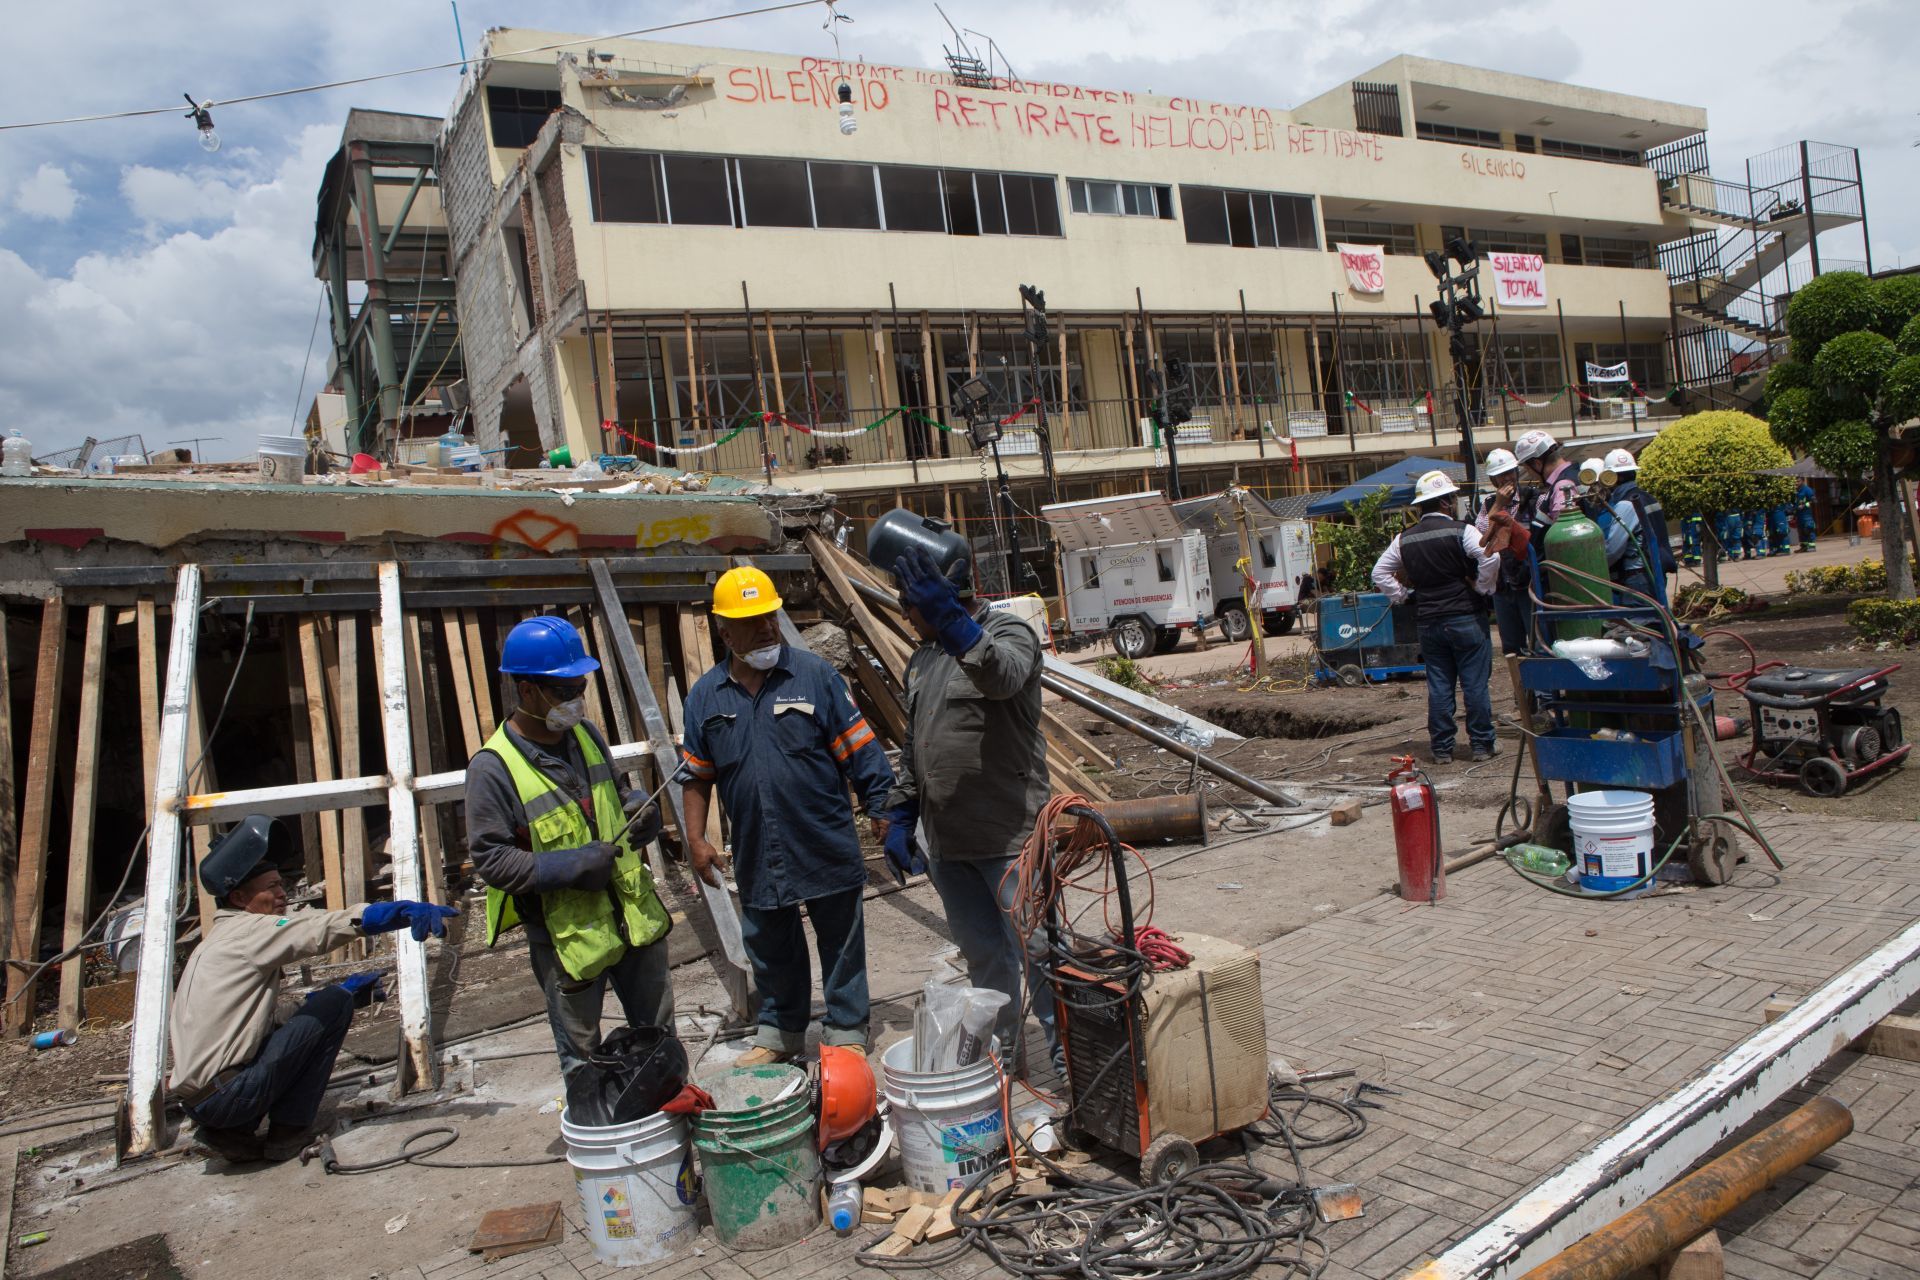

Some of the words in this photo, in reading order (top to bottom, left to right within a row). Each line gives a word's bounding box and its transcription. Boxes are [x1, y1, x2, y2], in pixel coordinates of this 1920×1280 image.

[726, 67, 890, 112] SILENCIO
[934, 88, 1121, 145] RETIRATE
[1461, 152, 1526, 178] SILENCIO
[1494, 255, 1543, 273] SILENCIO
[1359, 271, 1384, 289] NO
[1501, 279, 1543, 299] TOTAL
[1587, 365, 1626, 377] SILENCIO
[1110, 556, 1146, 566] CONAGUA
[959, 1033, 975, 1066] ESAB
